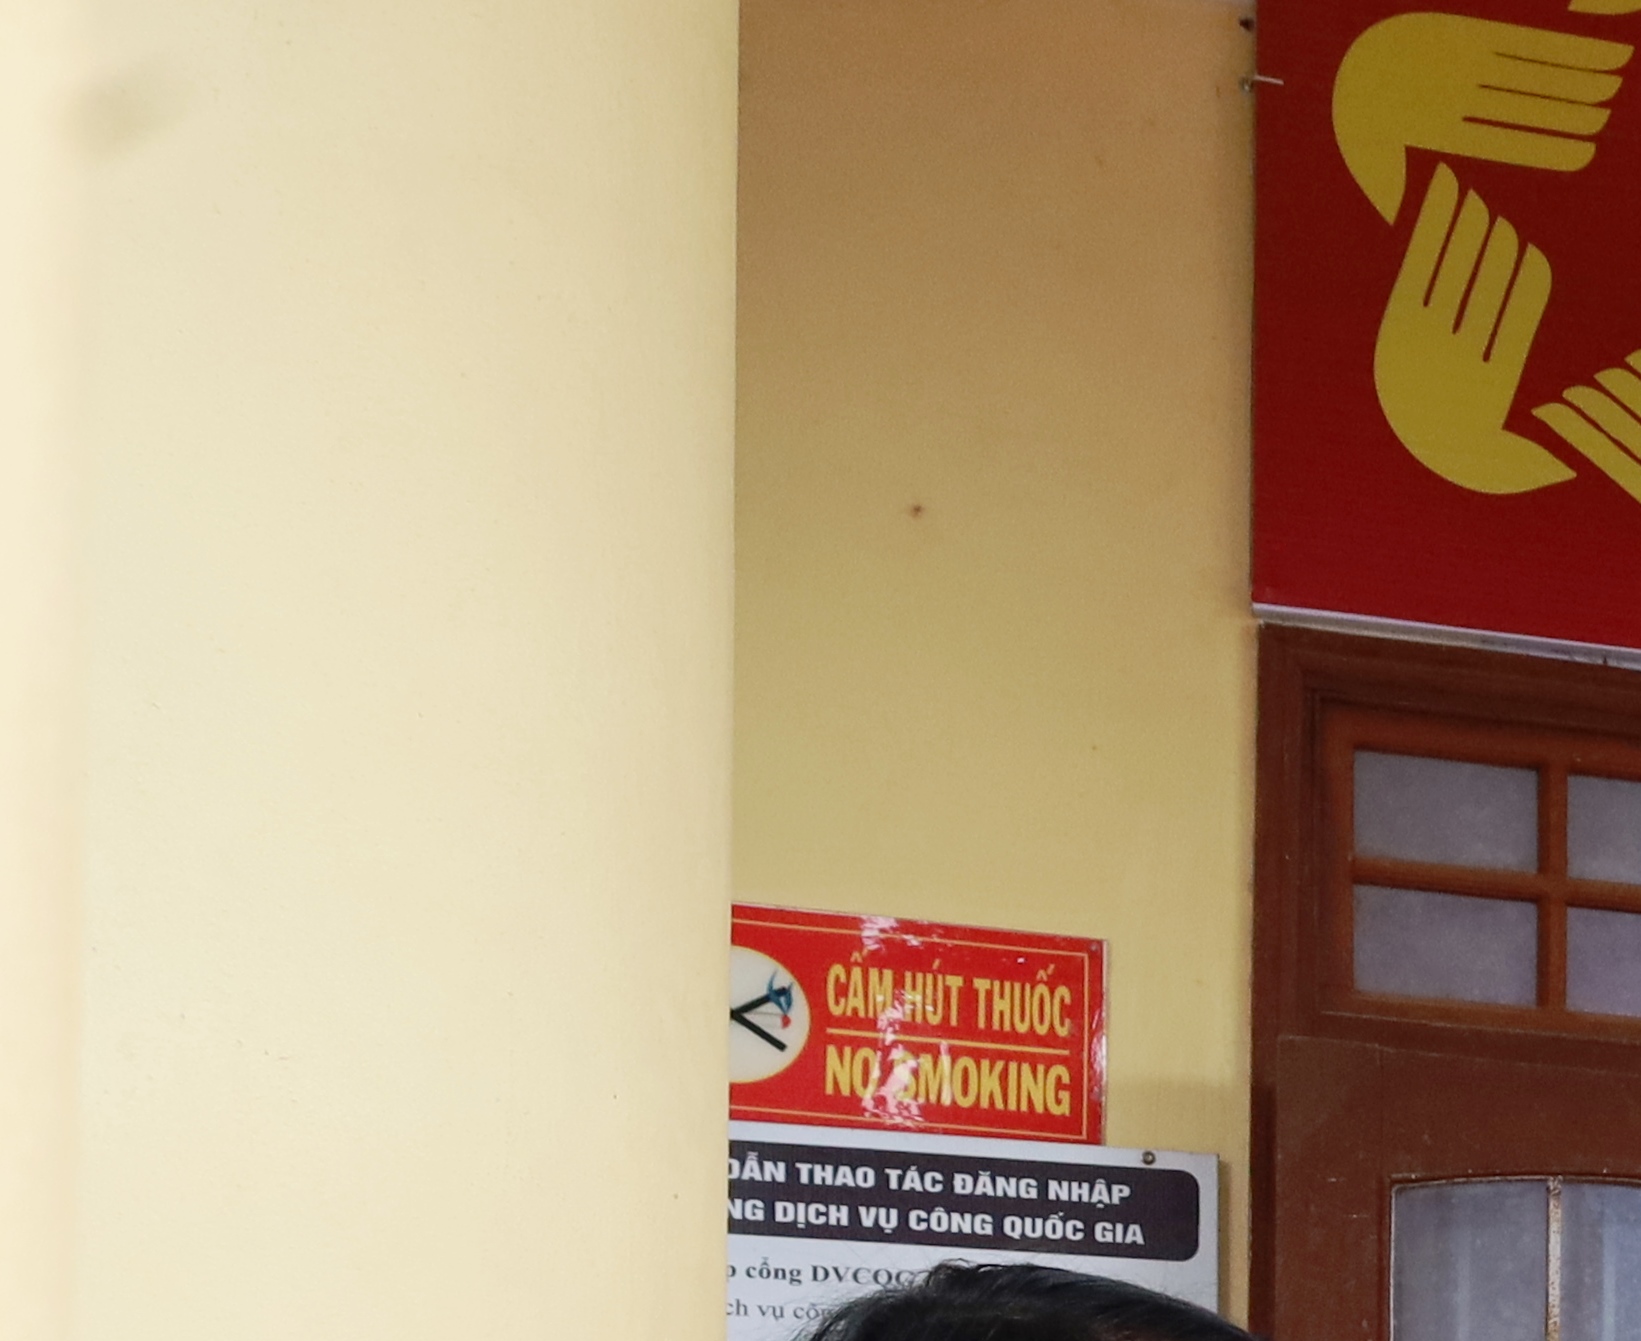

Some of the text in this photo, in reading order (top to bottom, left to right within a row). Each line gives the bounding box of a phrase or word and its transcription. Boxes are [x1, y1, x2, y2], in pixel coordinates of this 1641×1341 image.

[826, 948, 1071, 1037] CẤM HÚT THUỐC
[825, 1044, 1071, 1117] NO SMOKING
[795, 1163, 875, 1188] THAO
[884, 1165, 943, 1193] TÁC
[953, 1170, 1038, 1200] ĐĂNG
[1048, 1179, 1131, 1208] NHẬP
[775, 1200, 849, 1229] DỊCH
[858, 1206, 898, 1234] VỤ
[908, 1207, 993, 1236] CÔNG
[1003, 1212, 1085, 1242] QUỐC
[1094, 1222, 1145, 1245] GIA
[745, 1257, 803, 1285] cổng
[756, 1305, 783, 1321] vụ
